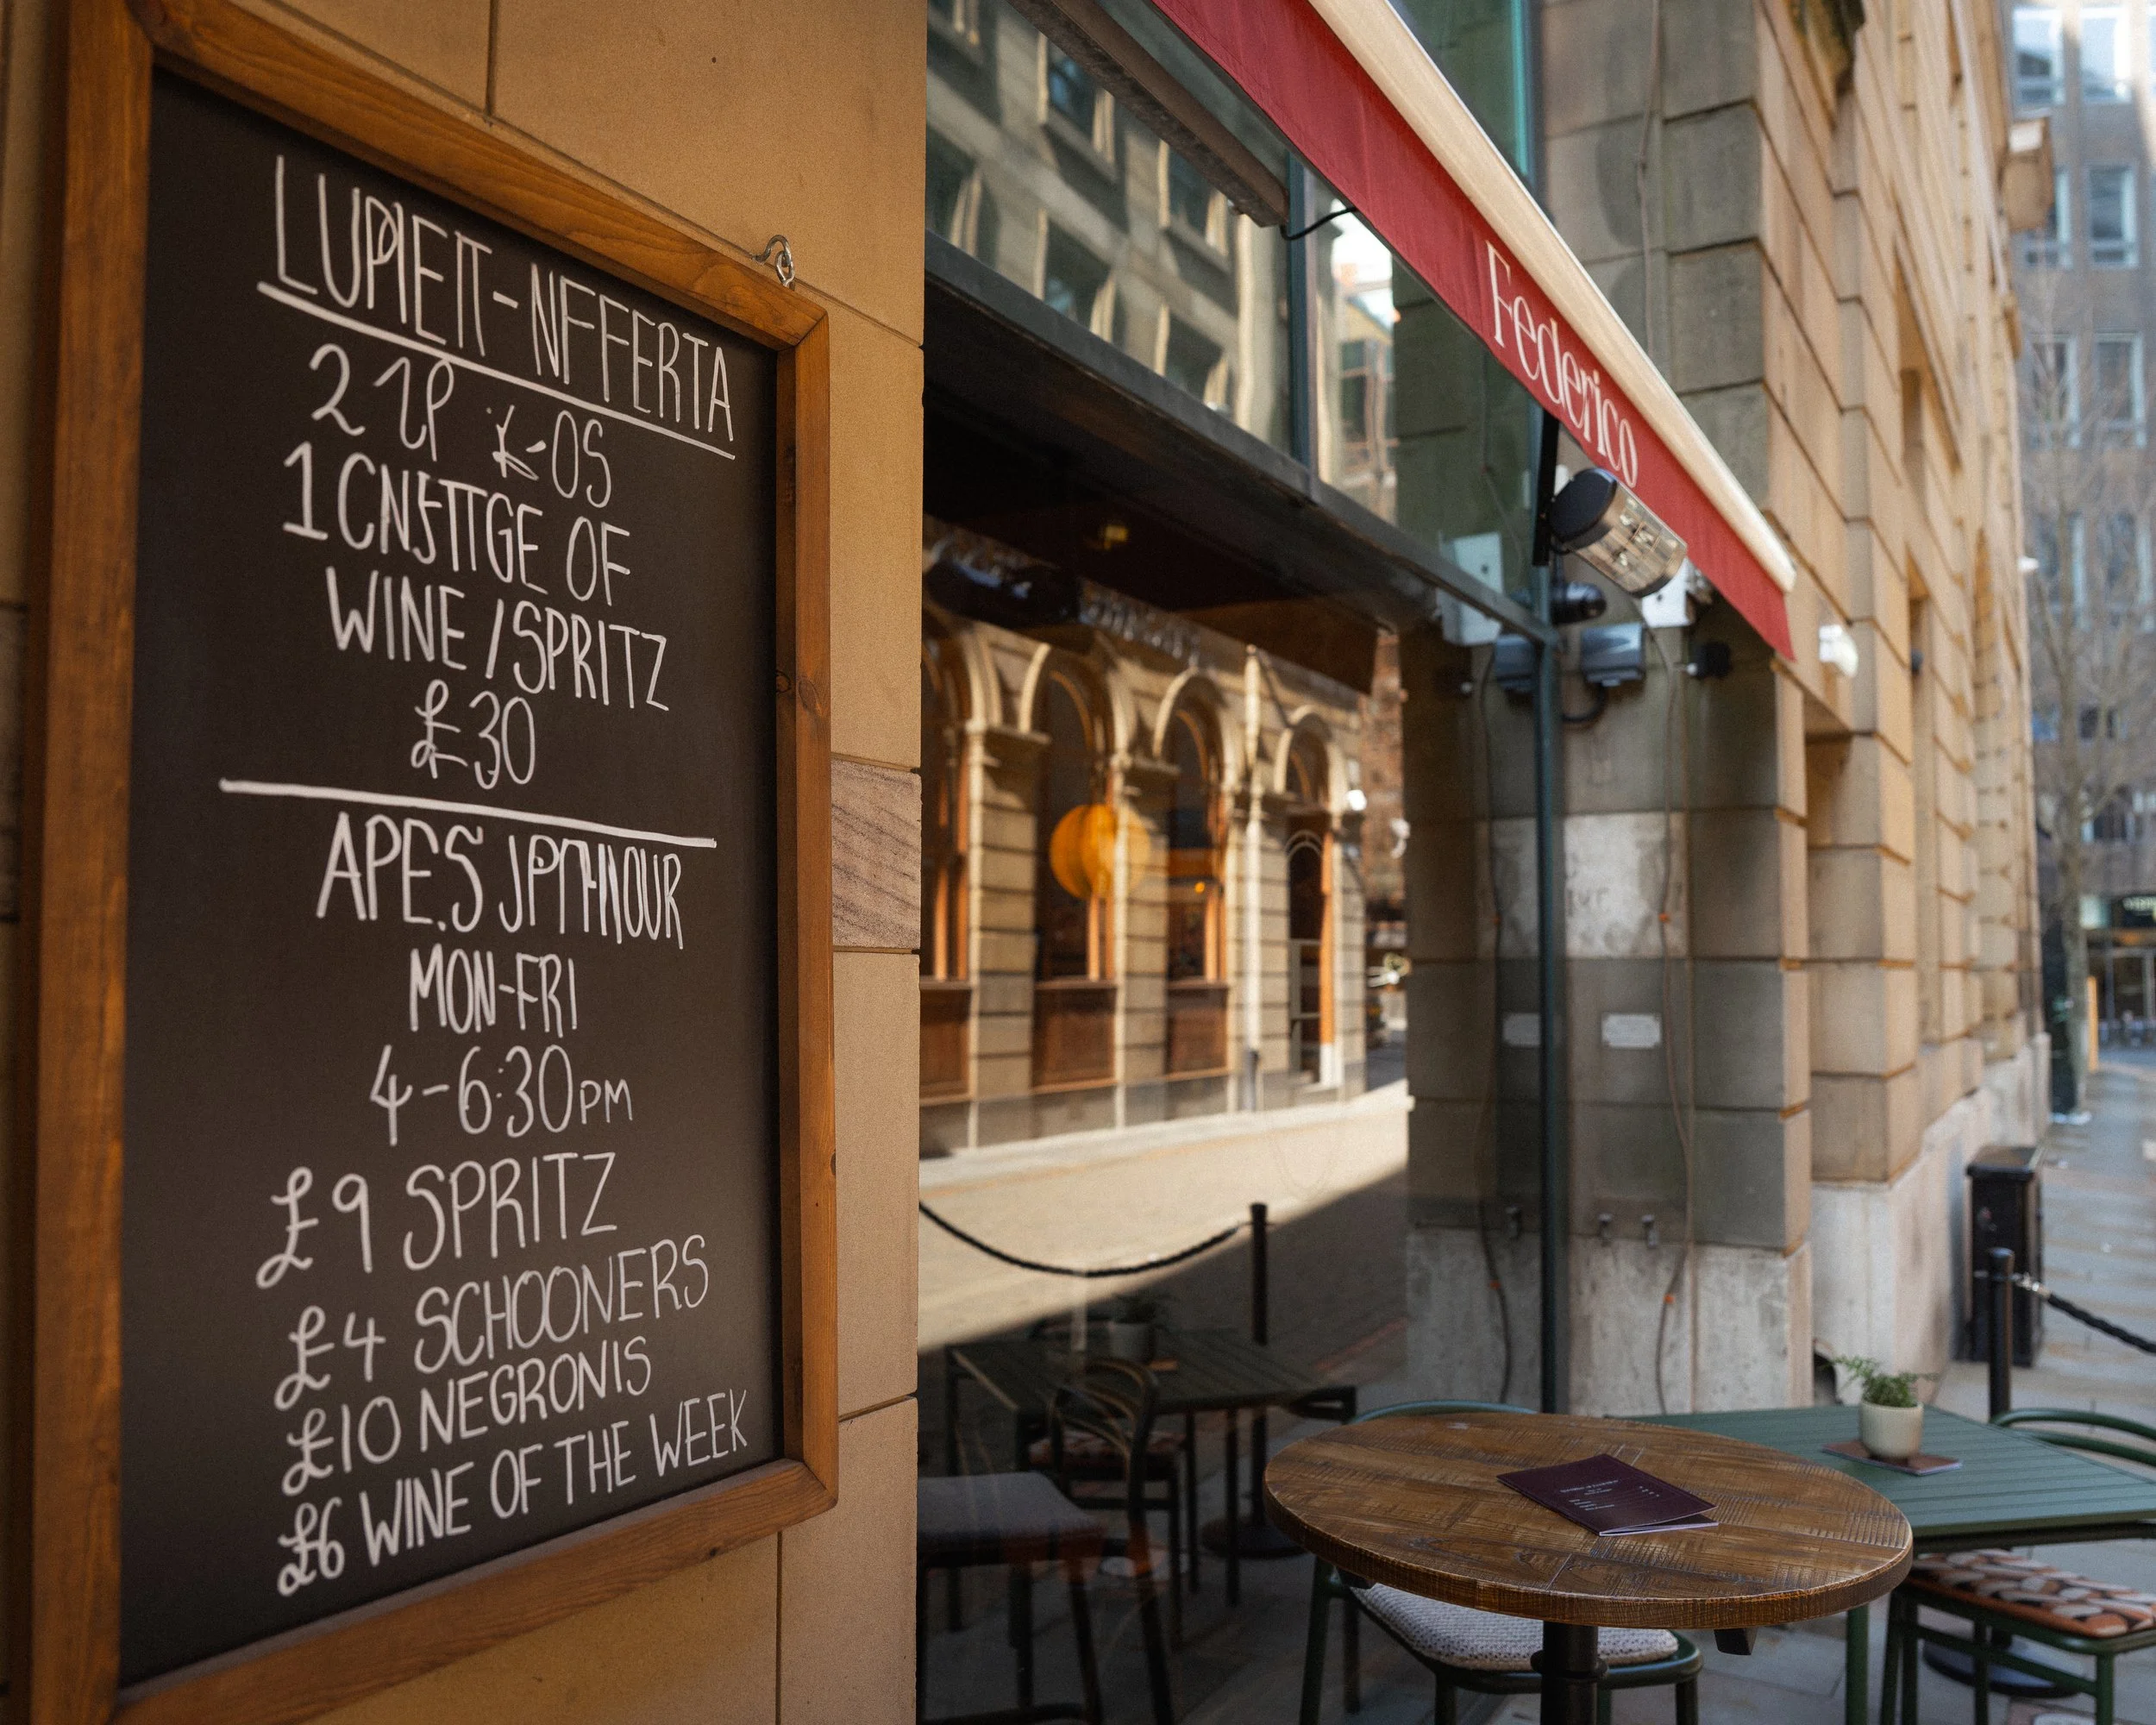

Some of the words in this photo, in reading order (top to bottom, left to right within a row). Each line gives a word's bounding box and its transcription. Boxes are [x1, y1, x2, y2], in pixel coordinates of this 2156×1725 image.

[309, 343, 366, 436] 2
[1486, 240, 1638, 488] Federico
[326, 566, 467, 670] WINE
[567, 517, 630, 606] OF
[411, 680, 536, 789] £30
[411, 943, 578, 1038] MON-FRI
[256, 1167, 373, 1289] £9
[403, 1152, 617, 1271] SPRITZ
[274, 1306, 385, 1410] £4
[414, 1234, 708, 1373] SCHOONERS
[282, 1396, 402, 1496] £10
[420, 1336, 652, 1452] NEGRONIS
[277, 1497, 344, 1596] £6
[360, 1461, 473, 1566] WINE
[490, 1444, 542, 1519] OF
[555, 1420, 636, 1505] THE
[649, 1389, 747, 1477] WEEK
